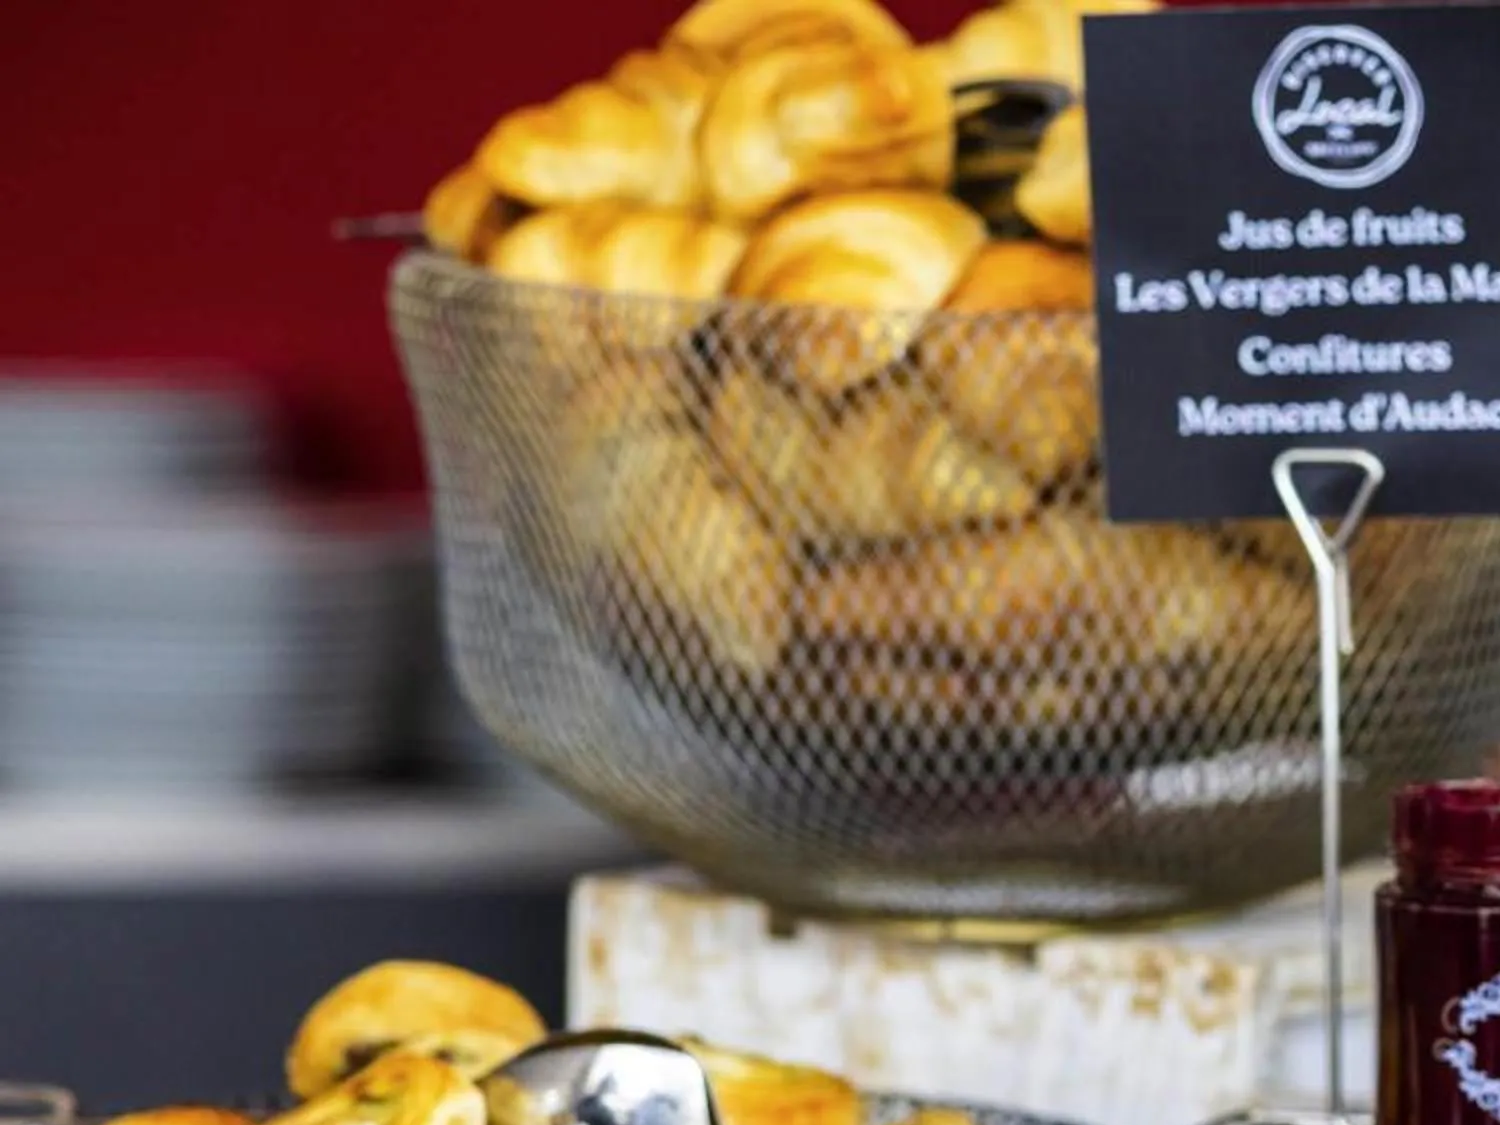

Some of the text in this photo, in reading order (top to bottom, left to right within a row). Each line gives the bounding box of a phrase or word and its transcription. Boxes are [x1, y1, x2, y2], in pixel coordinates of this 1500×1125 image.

[1219, 207, 1465, 250] Jus de fruits
[1115, 272, 1187, 312] Les
[1188, 269, 1349, 316] Vergers
[1351, 266, 1401, 304] de
[1405, 264, 1446, 303] la
[1238, 334, 1452, 376] Confitures
[1178, 396, 1344, 436] Moment
